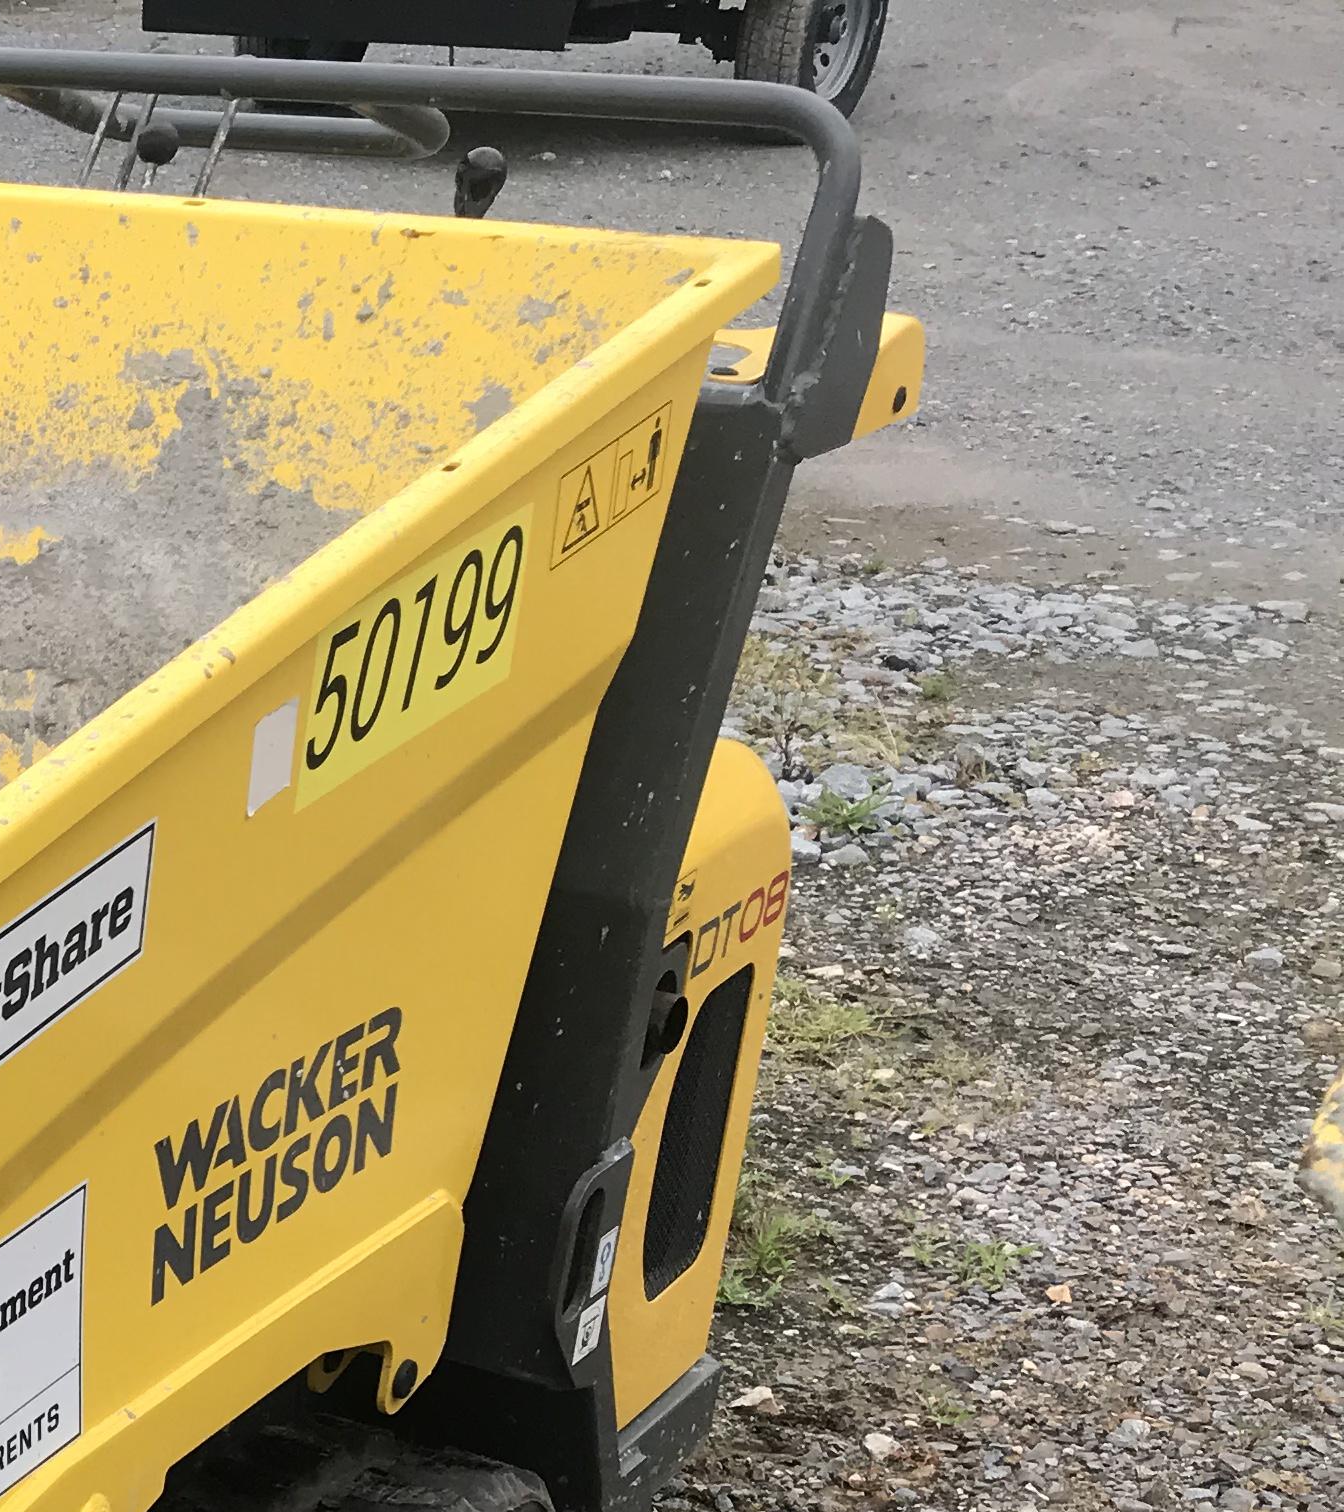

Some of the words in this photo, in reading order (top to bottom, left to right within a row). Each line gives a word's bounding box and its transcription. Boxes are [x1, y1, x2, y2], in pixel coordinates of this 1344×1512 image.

[306, 525, 523, 770] 50199
[690, 870, 789, 979] DT08
[150, 1081, 398, 1307] NEUSON
[153, 1006, 402, 1210] WACKER
